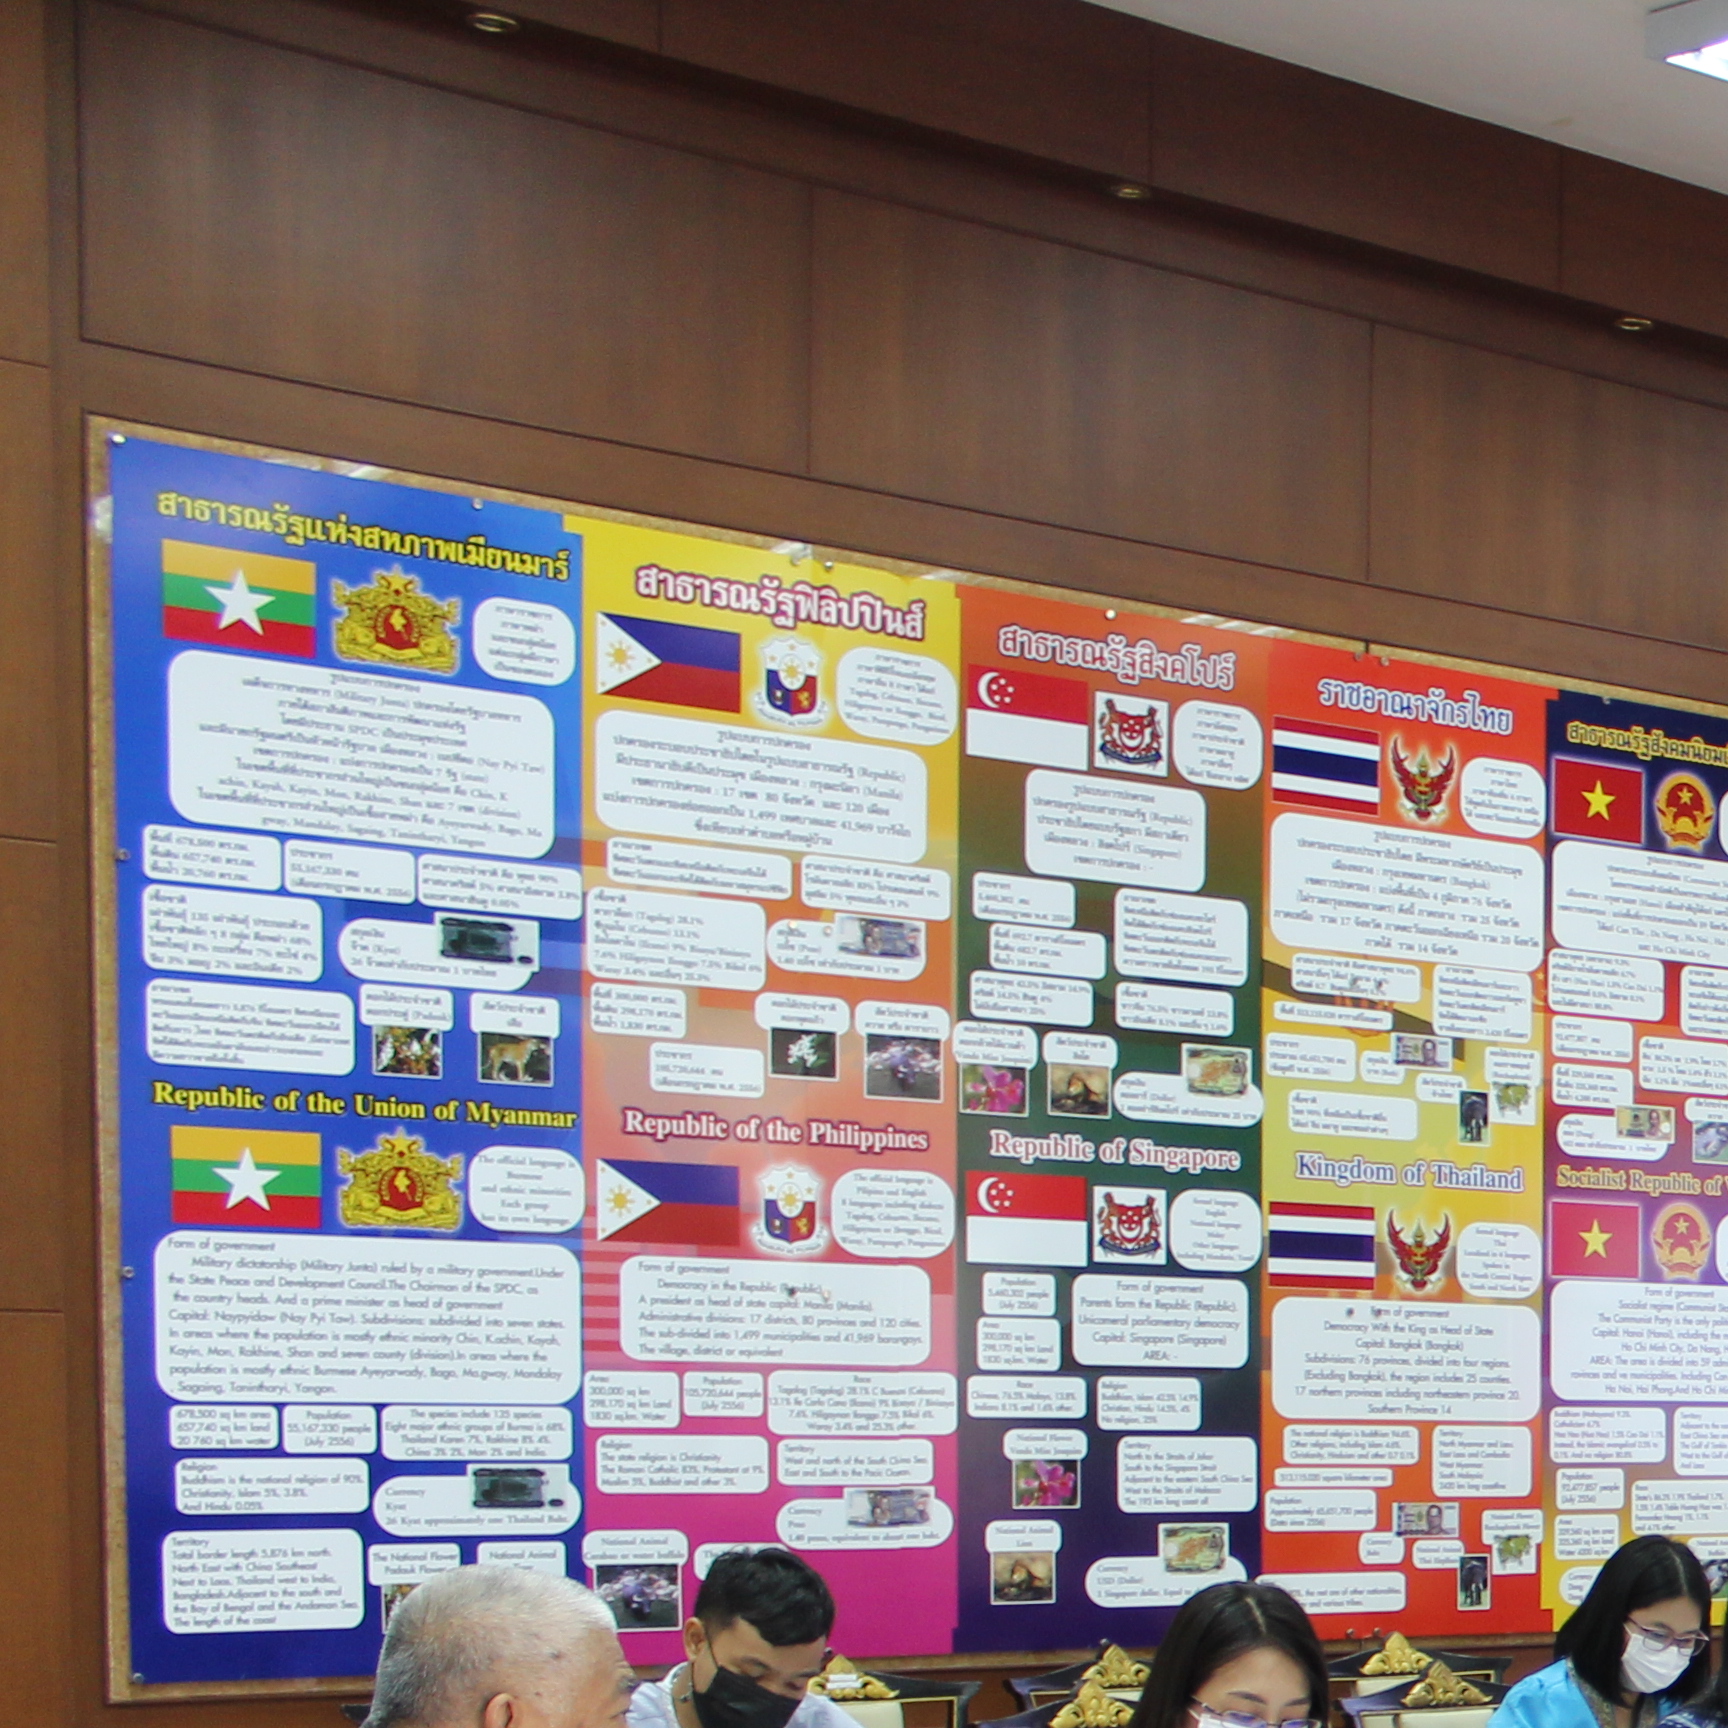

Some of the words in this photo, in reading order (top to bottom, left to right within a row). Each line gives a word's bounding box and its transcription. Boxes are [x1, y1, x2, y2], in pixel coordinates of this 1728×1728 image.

[157, 492, 570, 580] สาธารณรัฐแห่งสหภาพเมียนมาร์
[636, 564, 925, 641] สาธารณรัฐฟิลิปปินส์
[998, 625, 1236, 690] สาธารณรัฐสิงคโปร์
[1318, 679, 1513, 736] ราชอาณาจักรไทย
[153, 1081, 264, 1112] Republic
[274, 1091, 301, 1112] of
[306, 1093, 345, 1115] the
[354, 1094, 426, 1121] Union
[434, 1099, 458, 1121] of
[466, 1101, 577, 1130] Myanmar
[623, 1107, 728, 1141] Republic
[735, 1117, 761, 1140] of
[766, 1118, 801, 1143] the
[809, 1120, 929, 1152] Philippines
[990, 1129, 1094, 1164] Republic
[1099, 1137, 1125, 1161] of
[1129, 1139, 1241, 1173] Singapore
[1296, 1152, 1396, 1187] Kingdom
[1402, 1160, 1427, 1183] of
[1432, 1161, 1524, 1192] Thailand
[1557, 1165, 1626, 1190] Socialist
[1630, 1168, 1700, 1197] Republic
[1705, 1175, 1722, 1195] of
